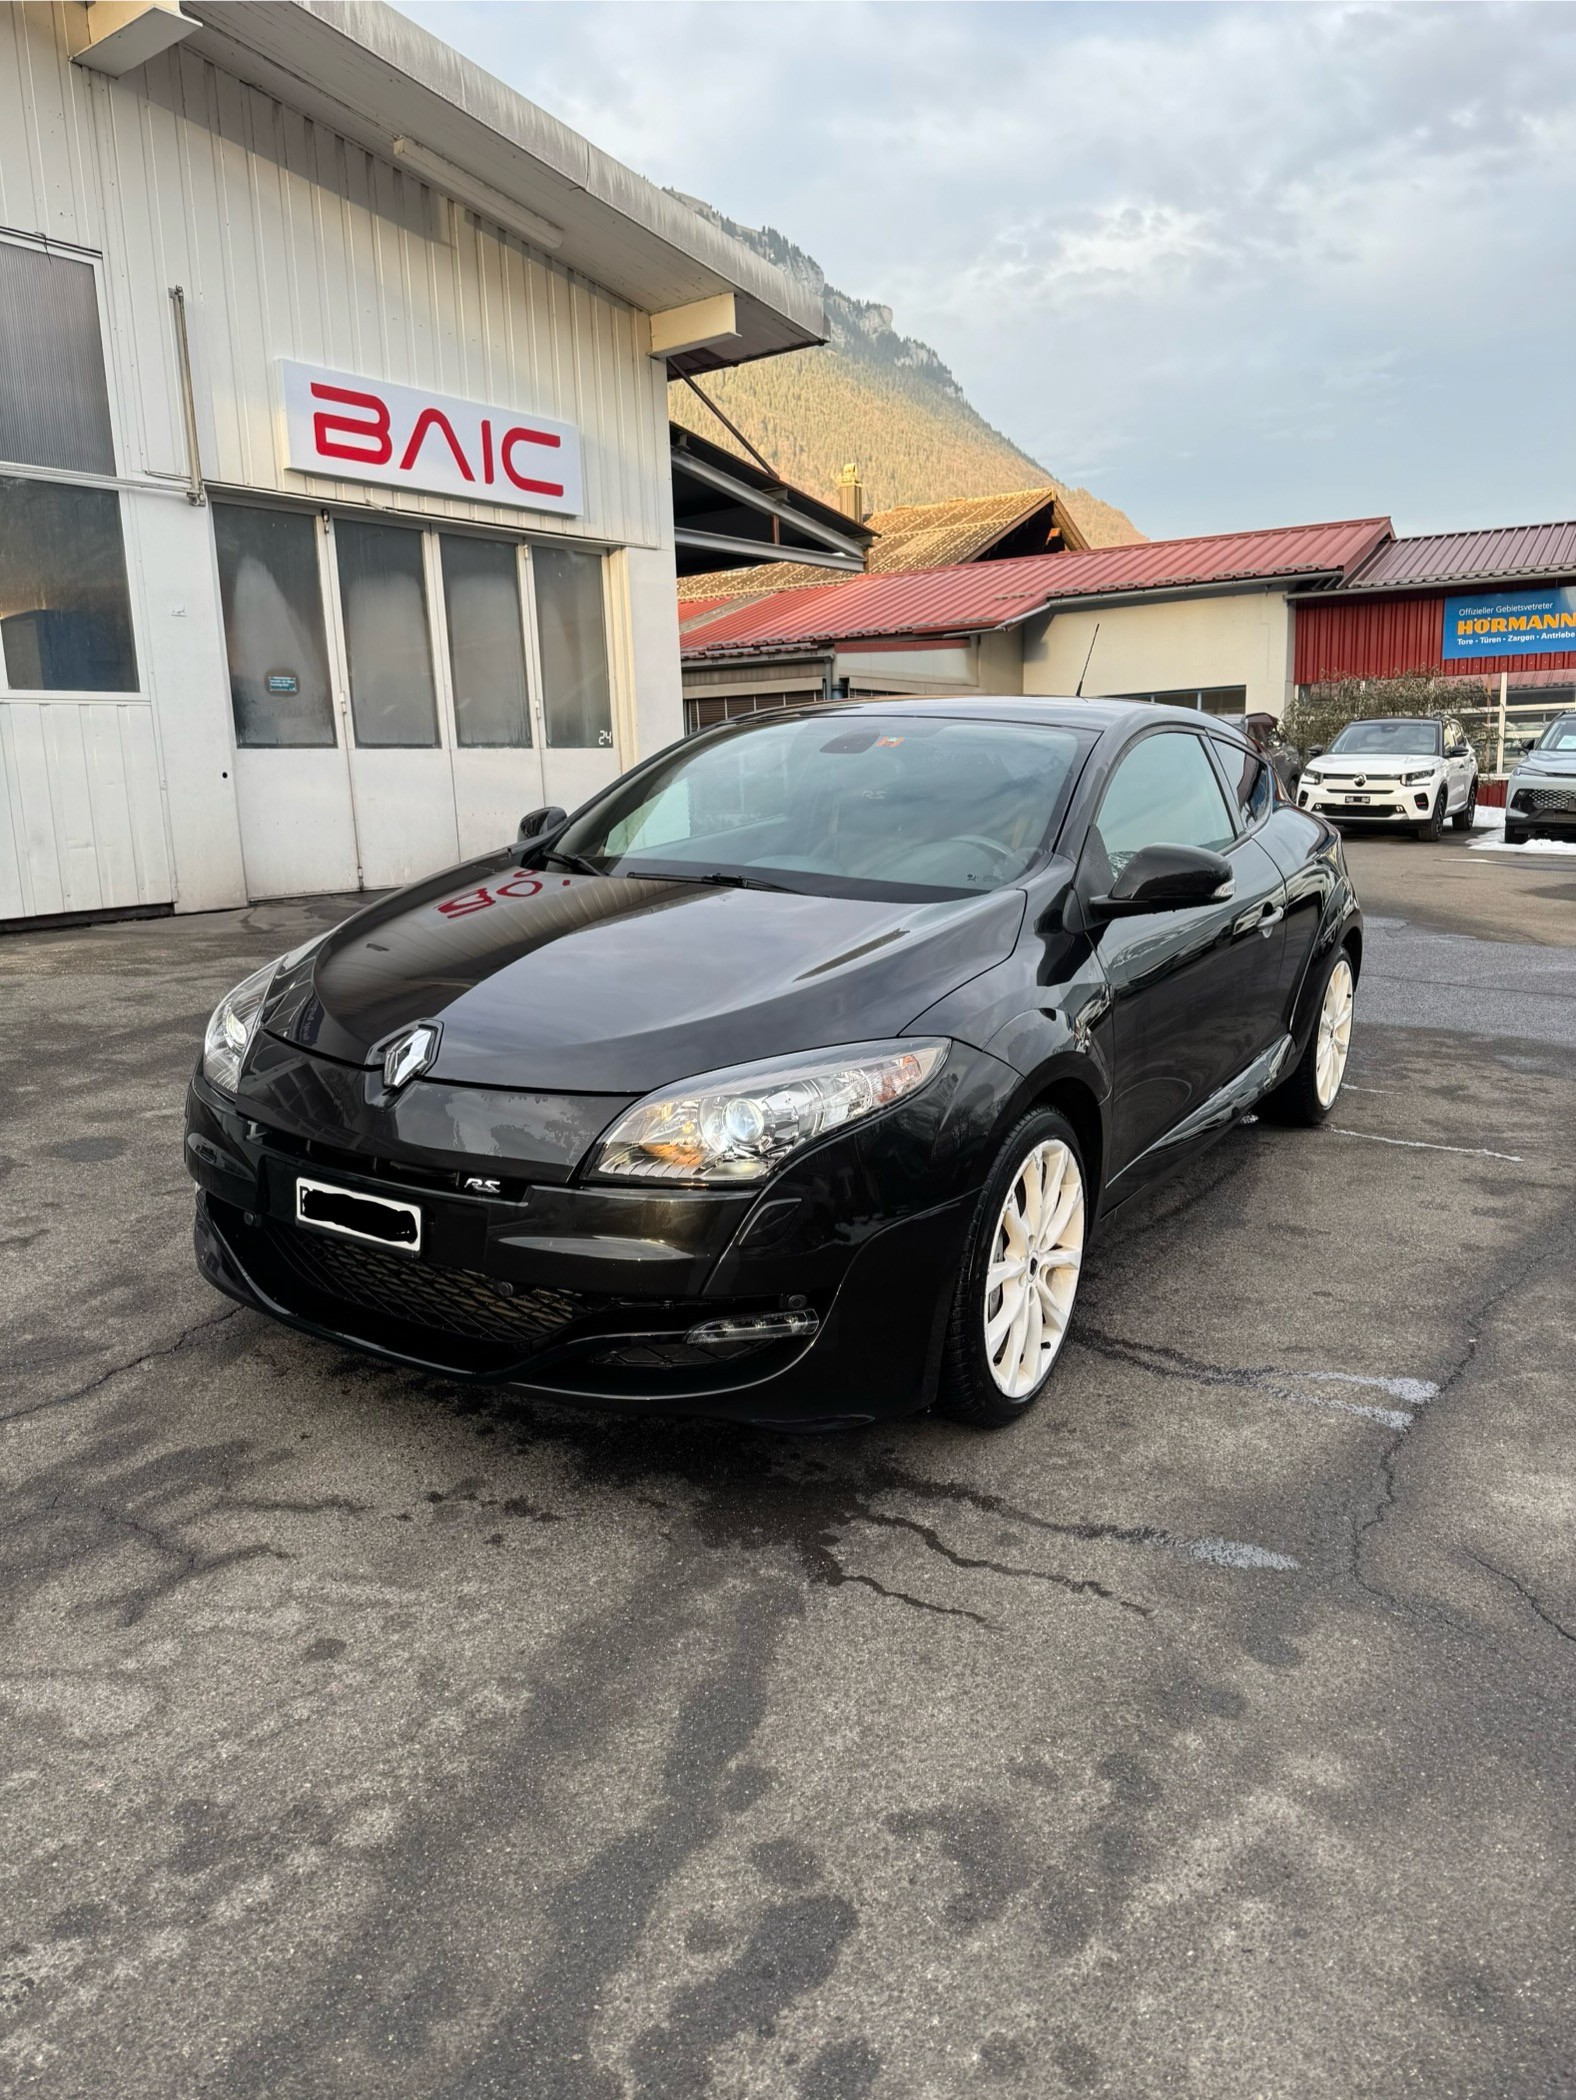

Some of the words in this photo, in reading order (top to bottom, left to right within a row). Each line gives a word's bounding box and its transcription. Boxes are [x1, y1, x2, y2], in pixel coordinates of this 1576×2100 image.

[310, 382, 564, 497] BAIC
[1458, 607, 1494, 616] Offizieller
[1495, 602, 1553, 613] Gebietsvetreter
[1457, 612, 1576, 635] HÖRMANN
[1457, 638, 1474, 646] Tore
[1480, 636, 1502, 644] Türen
[1507, 634, 1535, 643] Zargen
[1541, 630, 1576, 640] Antriebe
[599, 730, 612, 745] 24
[464, 1178, 501, 1193] RS
